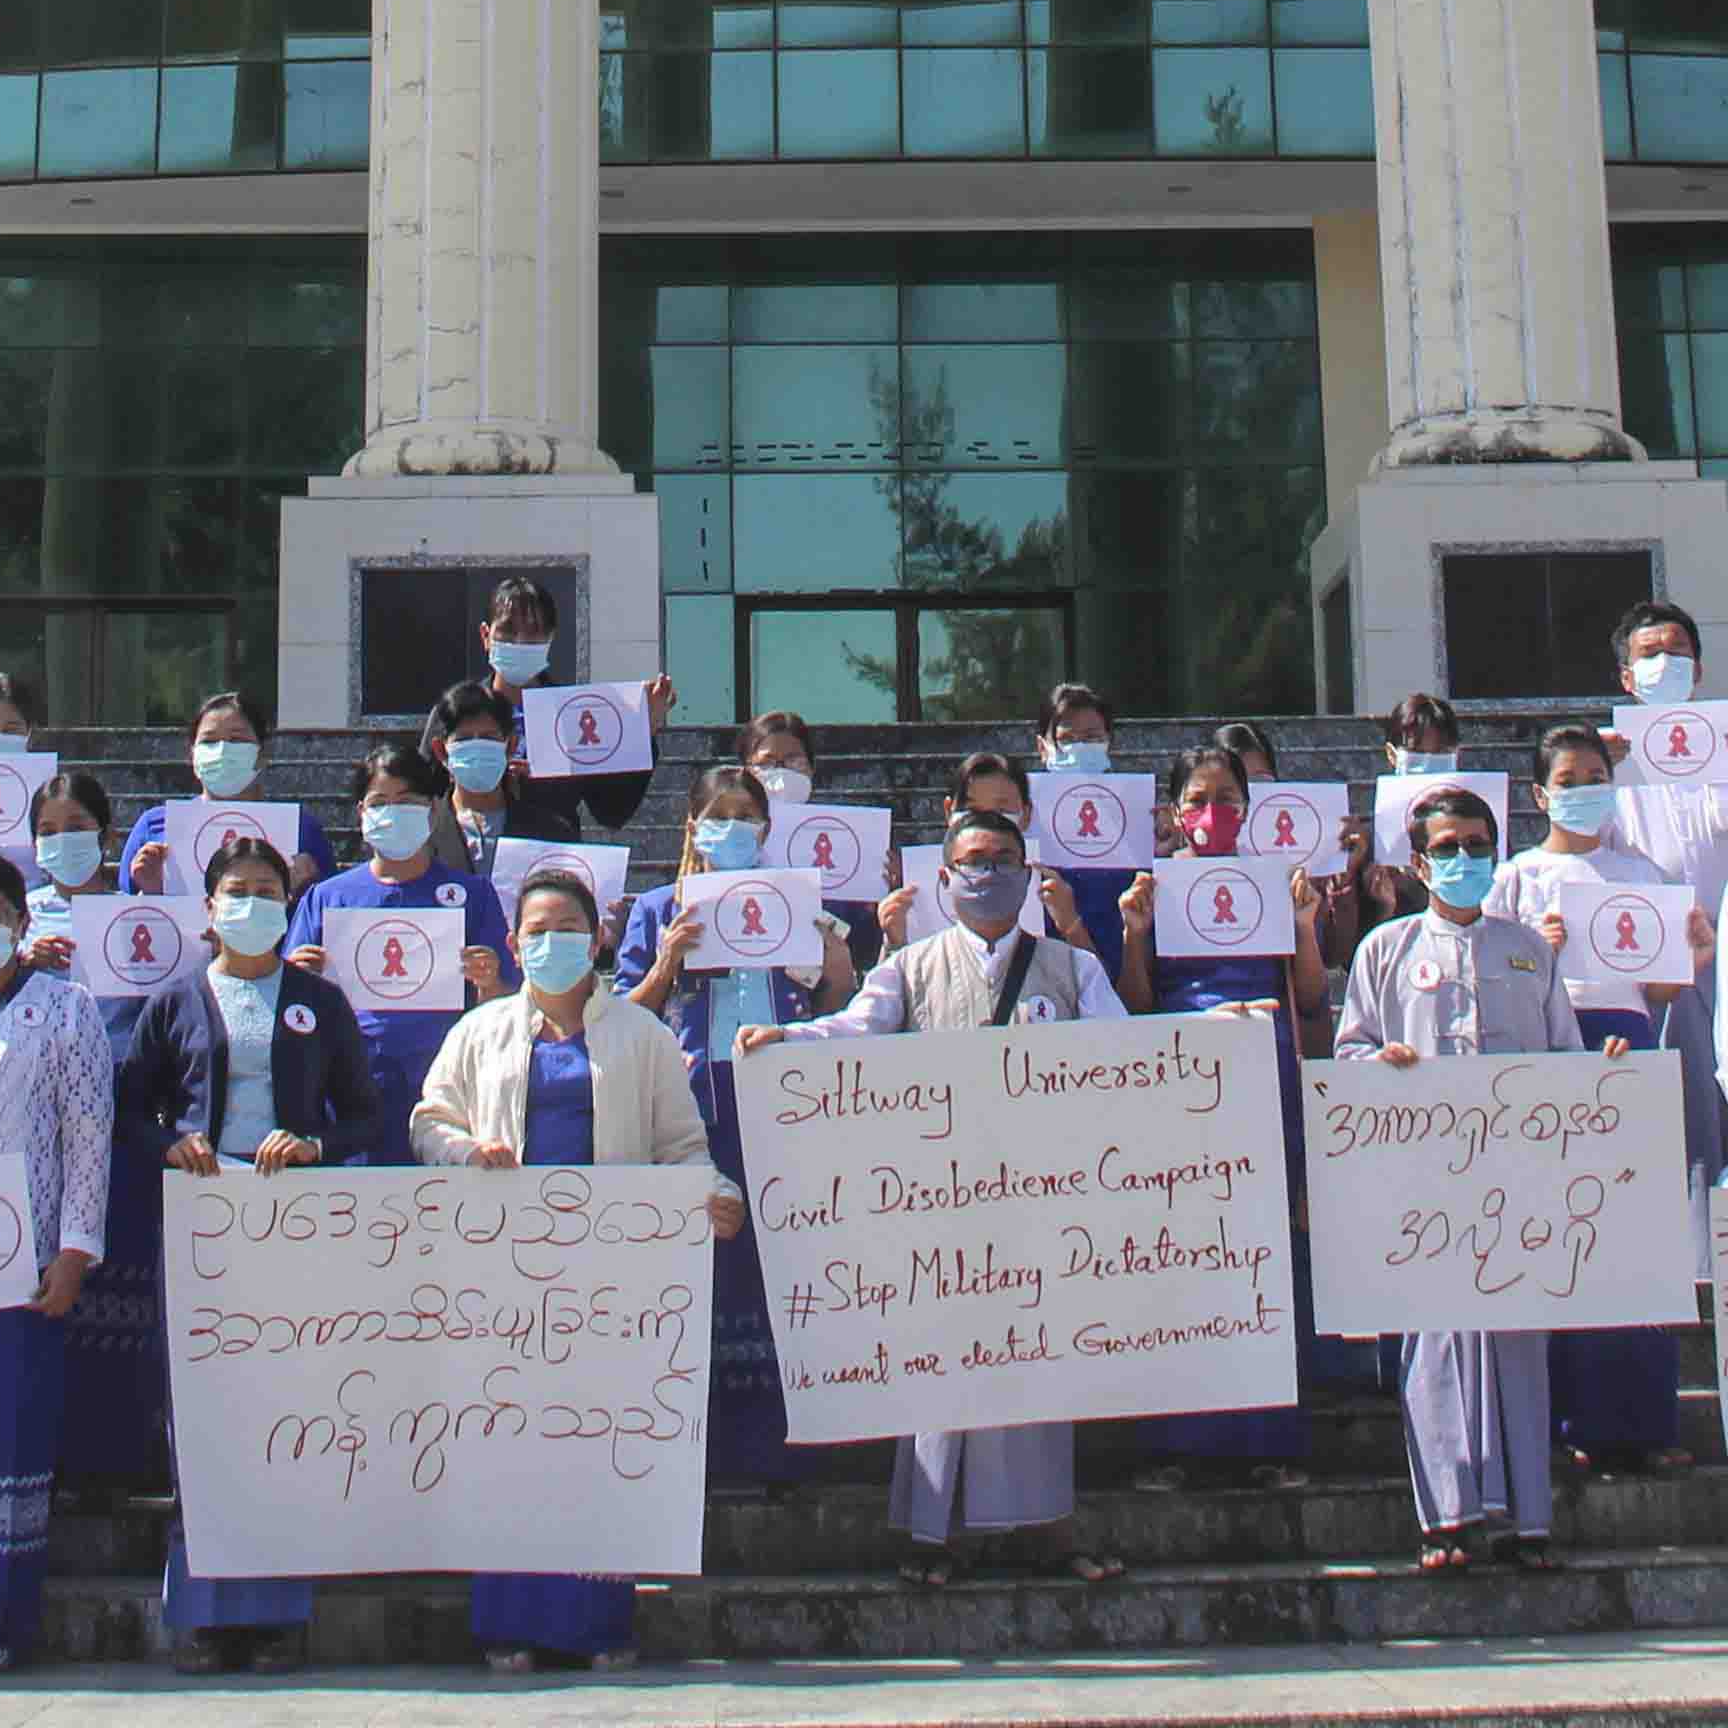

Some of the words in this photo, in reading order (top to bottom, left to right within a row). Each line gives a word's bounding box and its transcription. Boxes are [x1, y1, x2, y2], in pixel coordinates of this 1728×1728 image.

[776, 1060, 954, 1140] Sittway
[1002, 1031, 1222, 1113] University
[759, 1175, 846, 1233] Civil
[869, 1160, 1088, 1215] Disobedience
[1097, 1147, 1257, 1210] Campaign
[783, 1261, 898, 1332] #Stop
[909, 1242, 1044, 1308] Military
[1060, 1215, 1273, 1289] Dictatorship
[783, 1359, 815, 1392] We
[823, 1343, 890, 1386] want
[904, 1352, 947, 1377] our
[961, 1322, 1064, 1370] elected
[1073, 1293, 1288, 1358] Government
